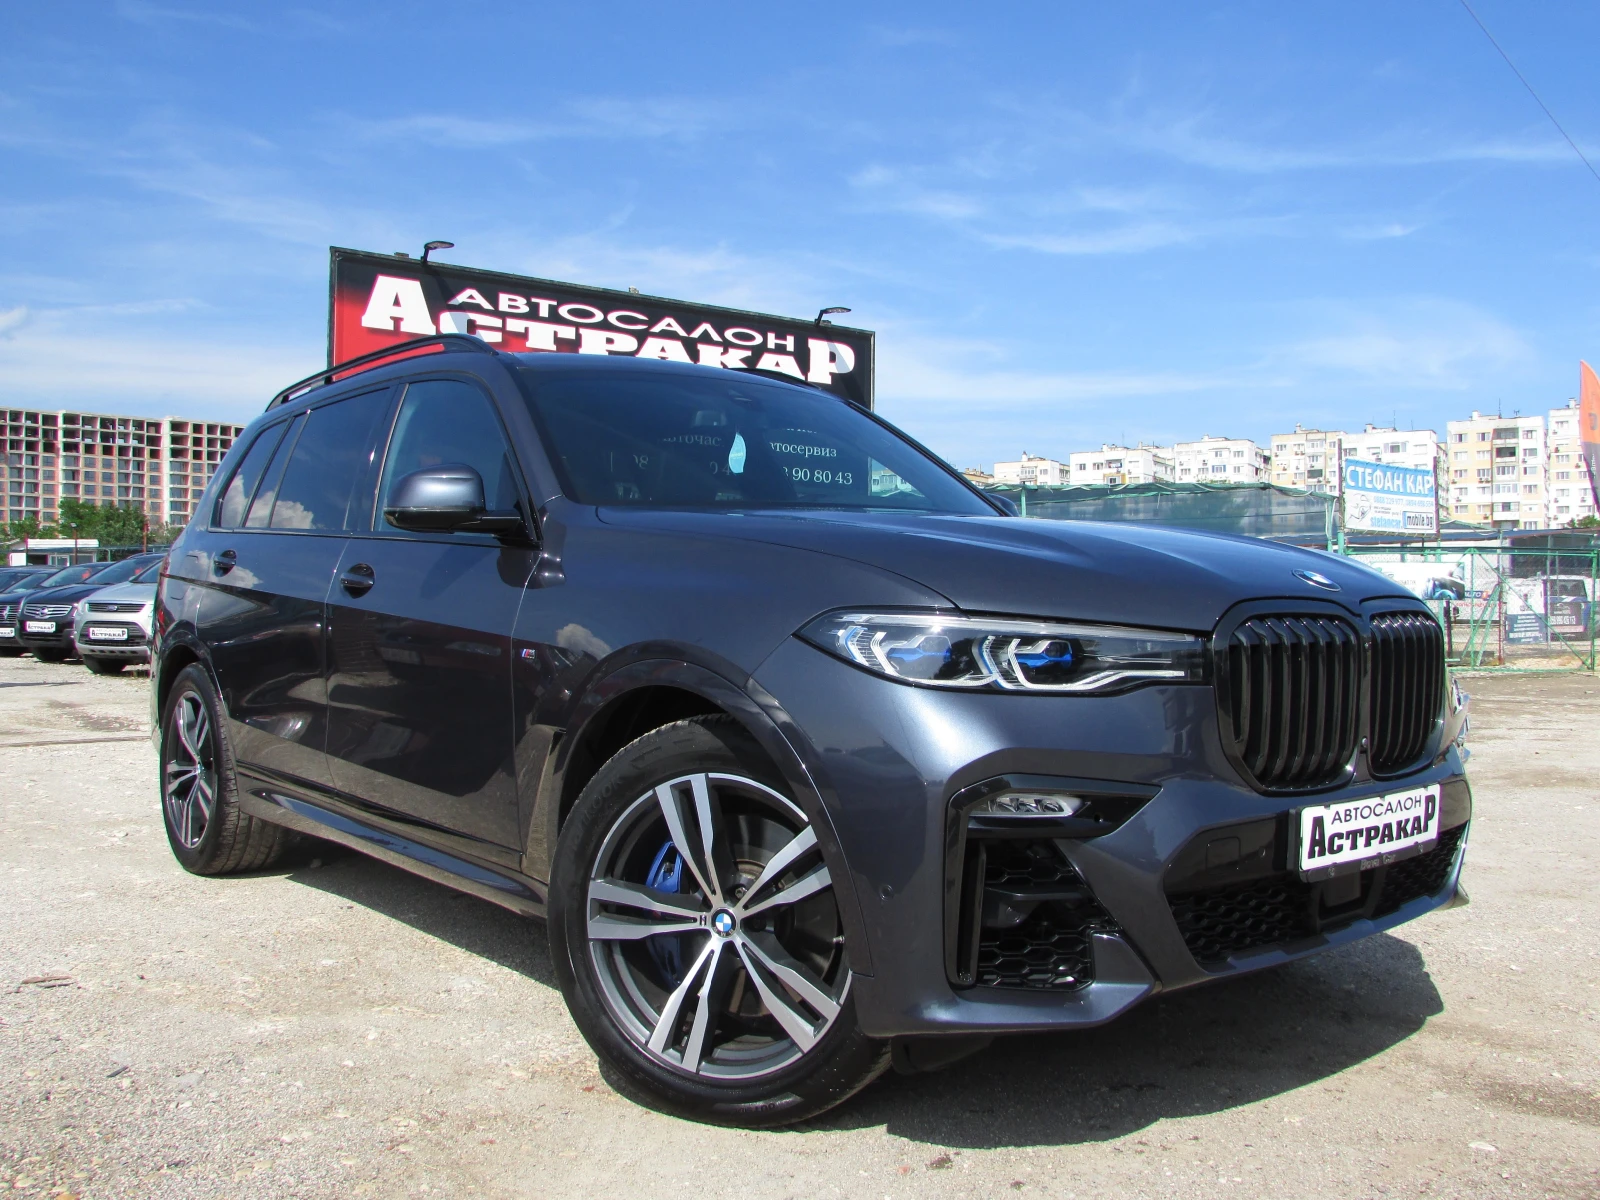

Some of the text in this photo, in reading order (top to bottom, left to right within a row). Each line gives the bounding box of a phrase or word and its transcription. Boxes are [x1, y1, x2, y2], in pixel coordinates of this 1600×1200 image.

[446, 287, 795, 352] АВТОСАЛОН
[768, 441, 837, 458] тосервиз
[792, 467, 810, 482] 90
[813, 469, 832, 484] 80
[834, 471, 853, 485] 43
[1346, 465, 1434, 495] СТЕФАН КАР
[1406, 514, 1433, 528] mobile.bg
[1331, 795, 1422, 825] АВТОСАЛОН
[1308, 794, 1436, 859] АСТРАКАР
